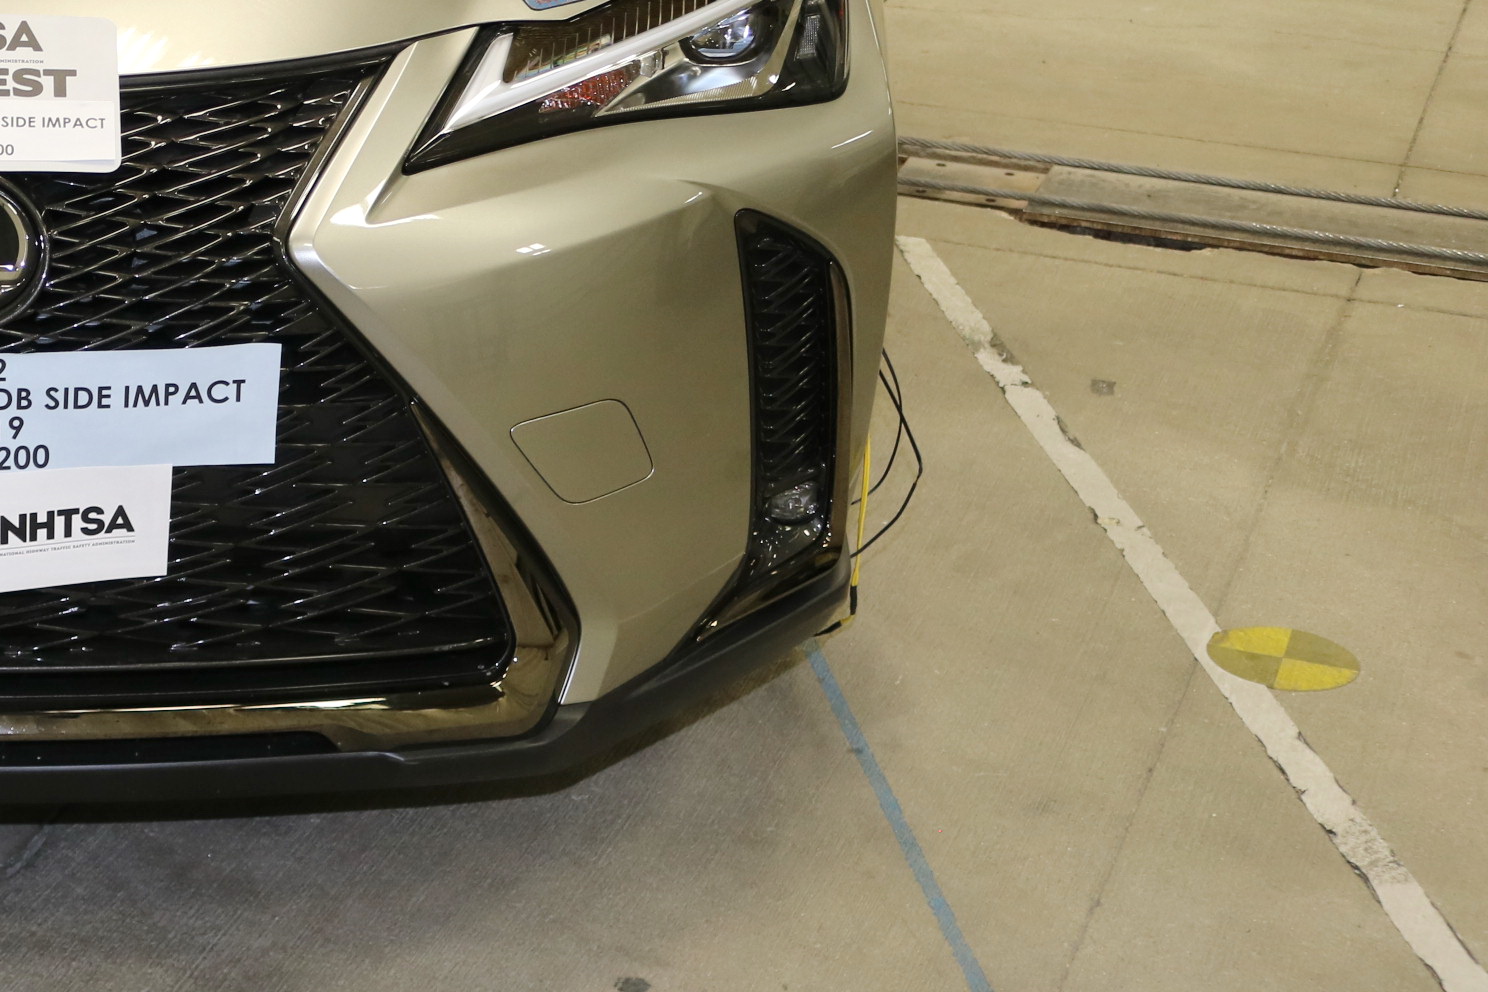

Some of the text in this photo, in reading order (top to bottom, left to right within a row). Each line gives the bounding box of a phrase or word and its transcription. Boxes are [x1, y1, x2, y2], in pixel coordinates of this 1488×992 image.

[1, 116, 35, 128] SIDE
[42, 117, 106, 129] IMPACT
[44, 385, 112, 411] SIDE
[123, 379, 246, 409] IMPACT
[0, 505, 135, 545] NHTSA
